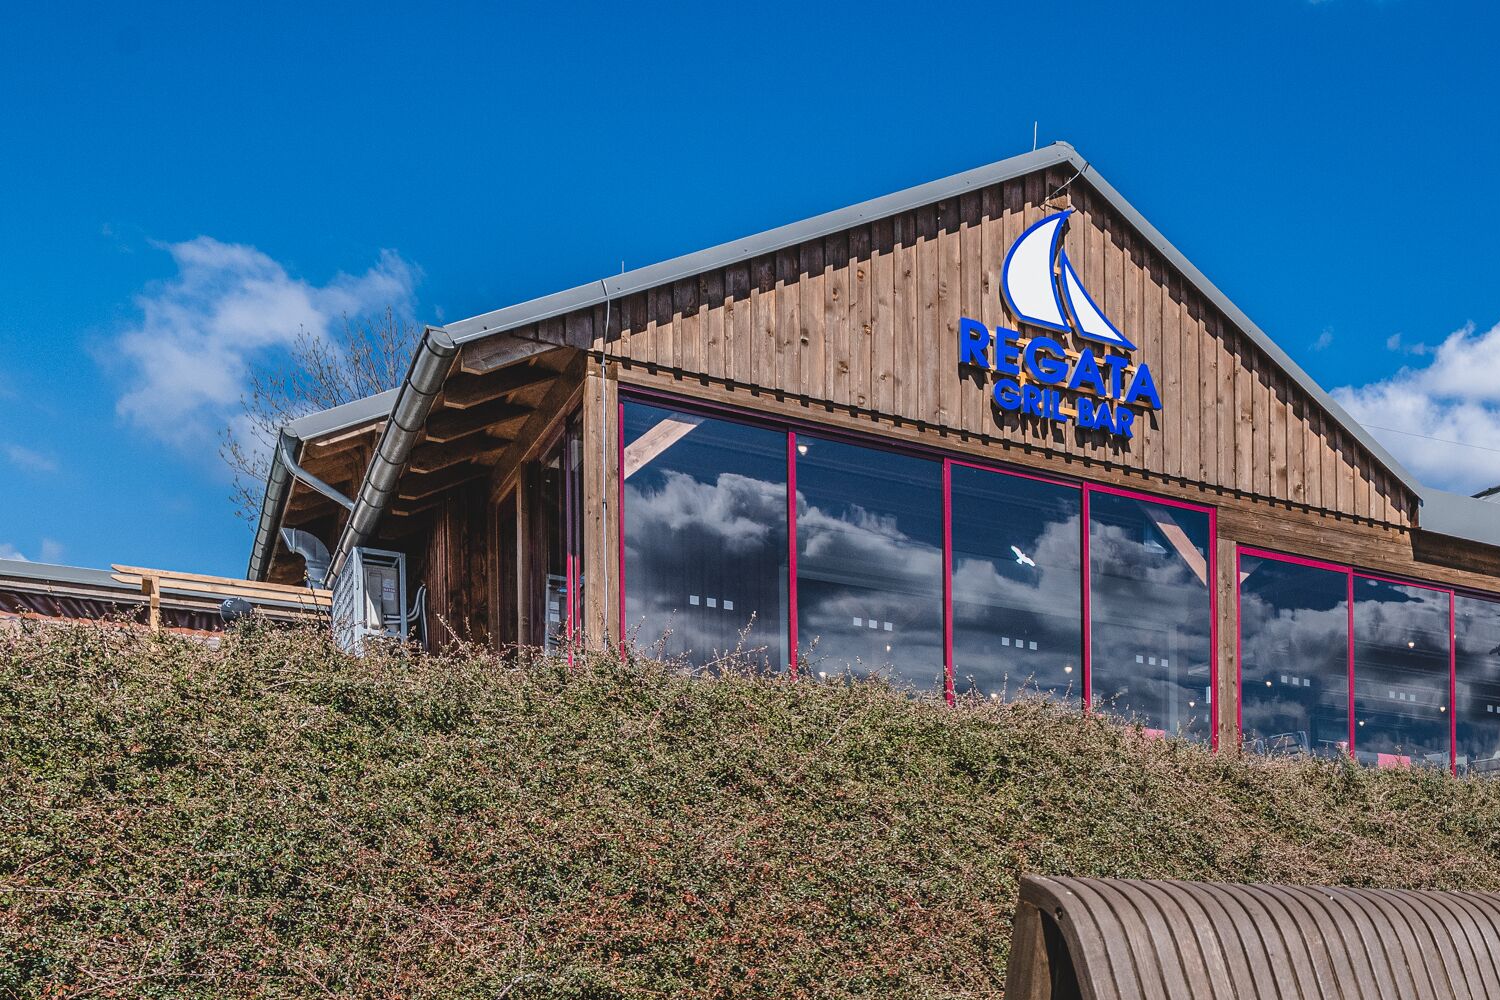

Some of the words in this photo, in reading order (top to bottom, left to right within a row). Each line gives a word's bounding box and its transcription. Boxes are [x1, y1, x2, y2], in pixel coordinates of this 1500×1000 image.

[960, 317, 1162, 410] REGATA
[994, 378, 1068, 423] GRIL
[1078, 397, 1134, 438] BAR
